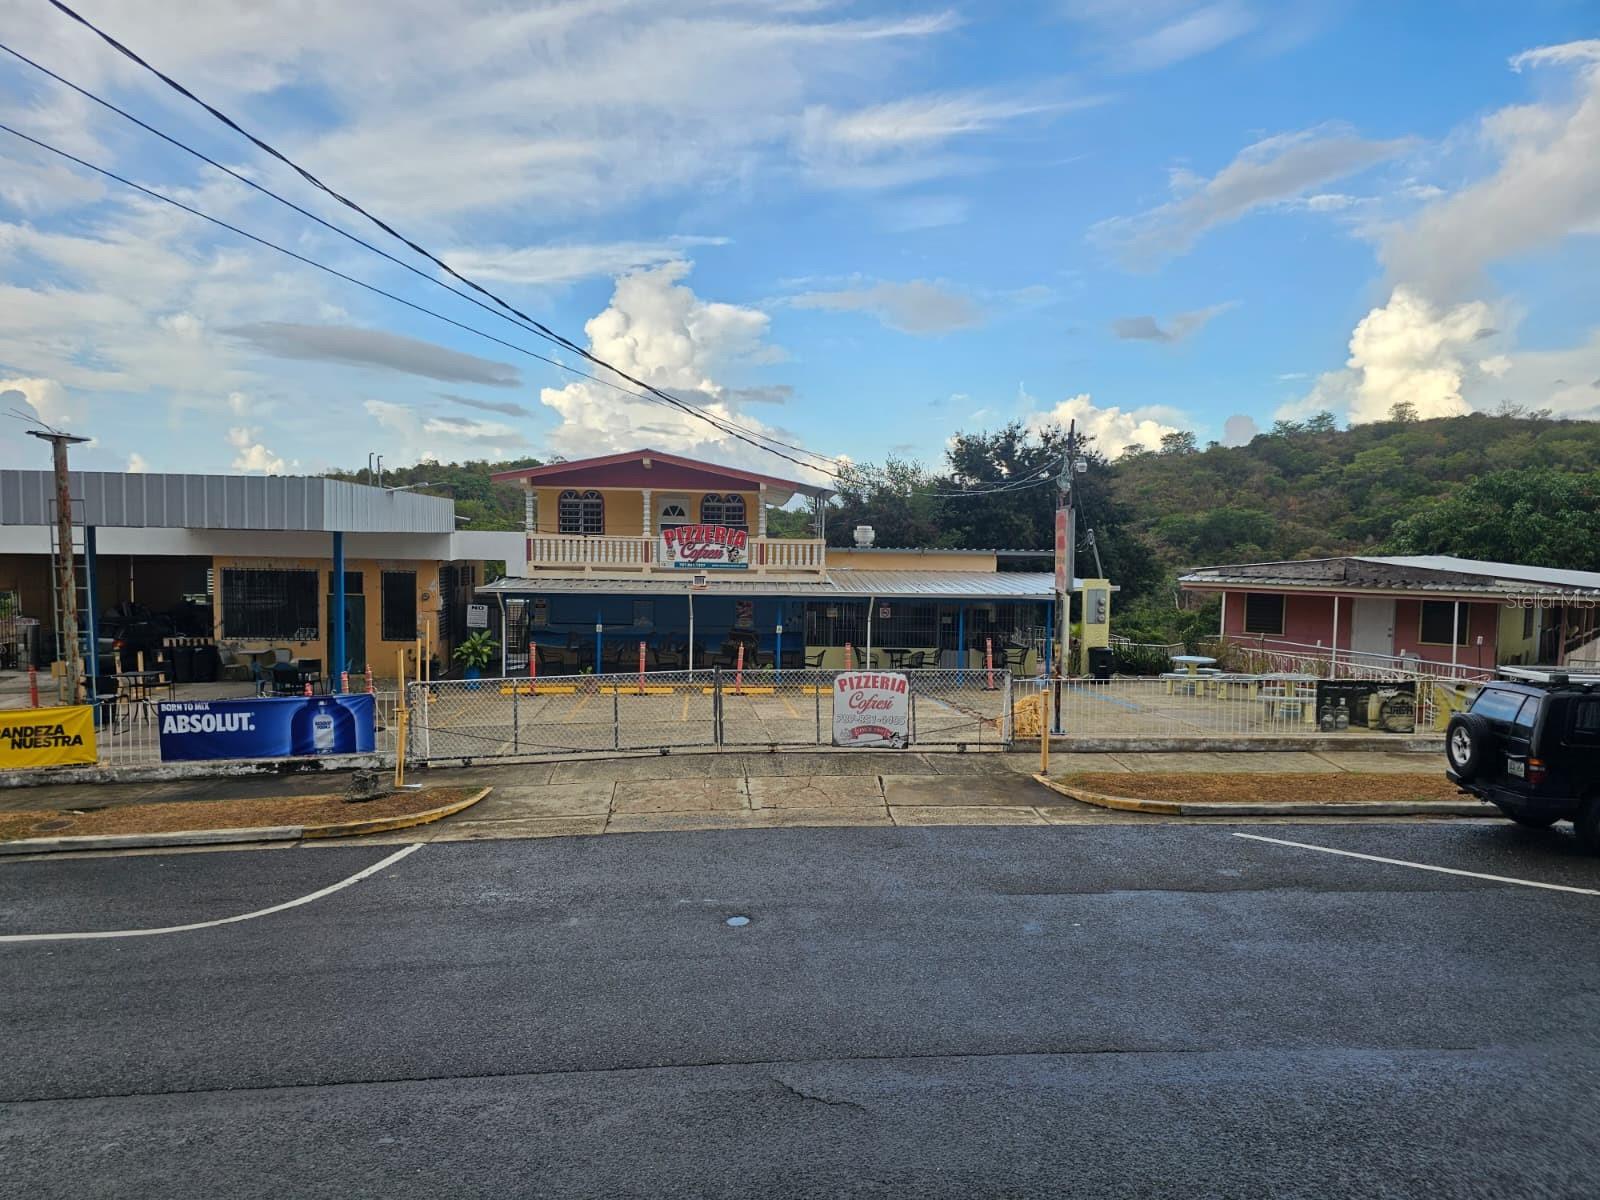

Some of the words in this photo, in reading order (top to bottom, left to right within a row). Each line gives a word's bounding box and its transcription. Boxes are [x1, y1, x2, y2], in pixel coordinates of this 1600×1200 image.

[663, 525, 747, 550] PIZZERIA
[837, 675, 907, 694] PIZZERIA
[160, 703, 182, 712] BORN
[184, 703, 194, 711] TO
[195, 702, 211, 711] MIX
[848, 691, 895, 715] Cofresí
[0, 724, 65, 740] ANDEZA
[11, 734, 84, 751] NUESTRA
